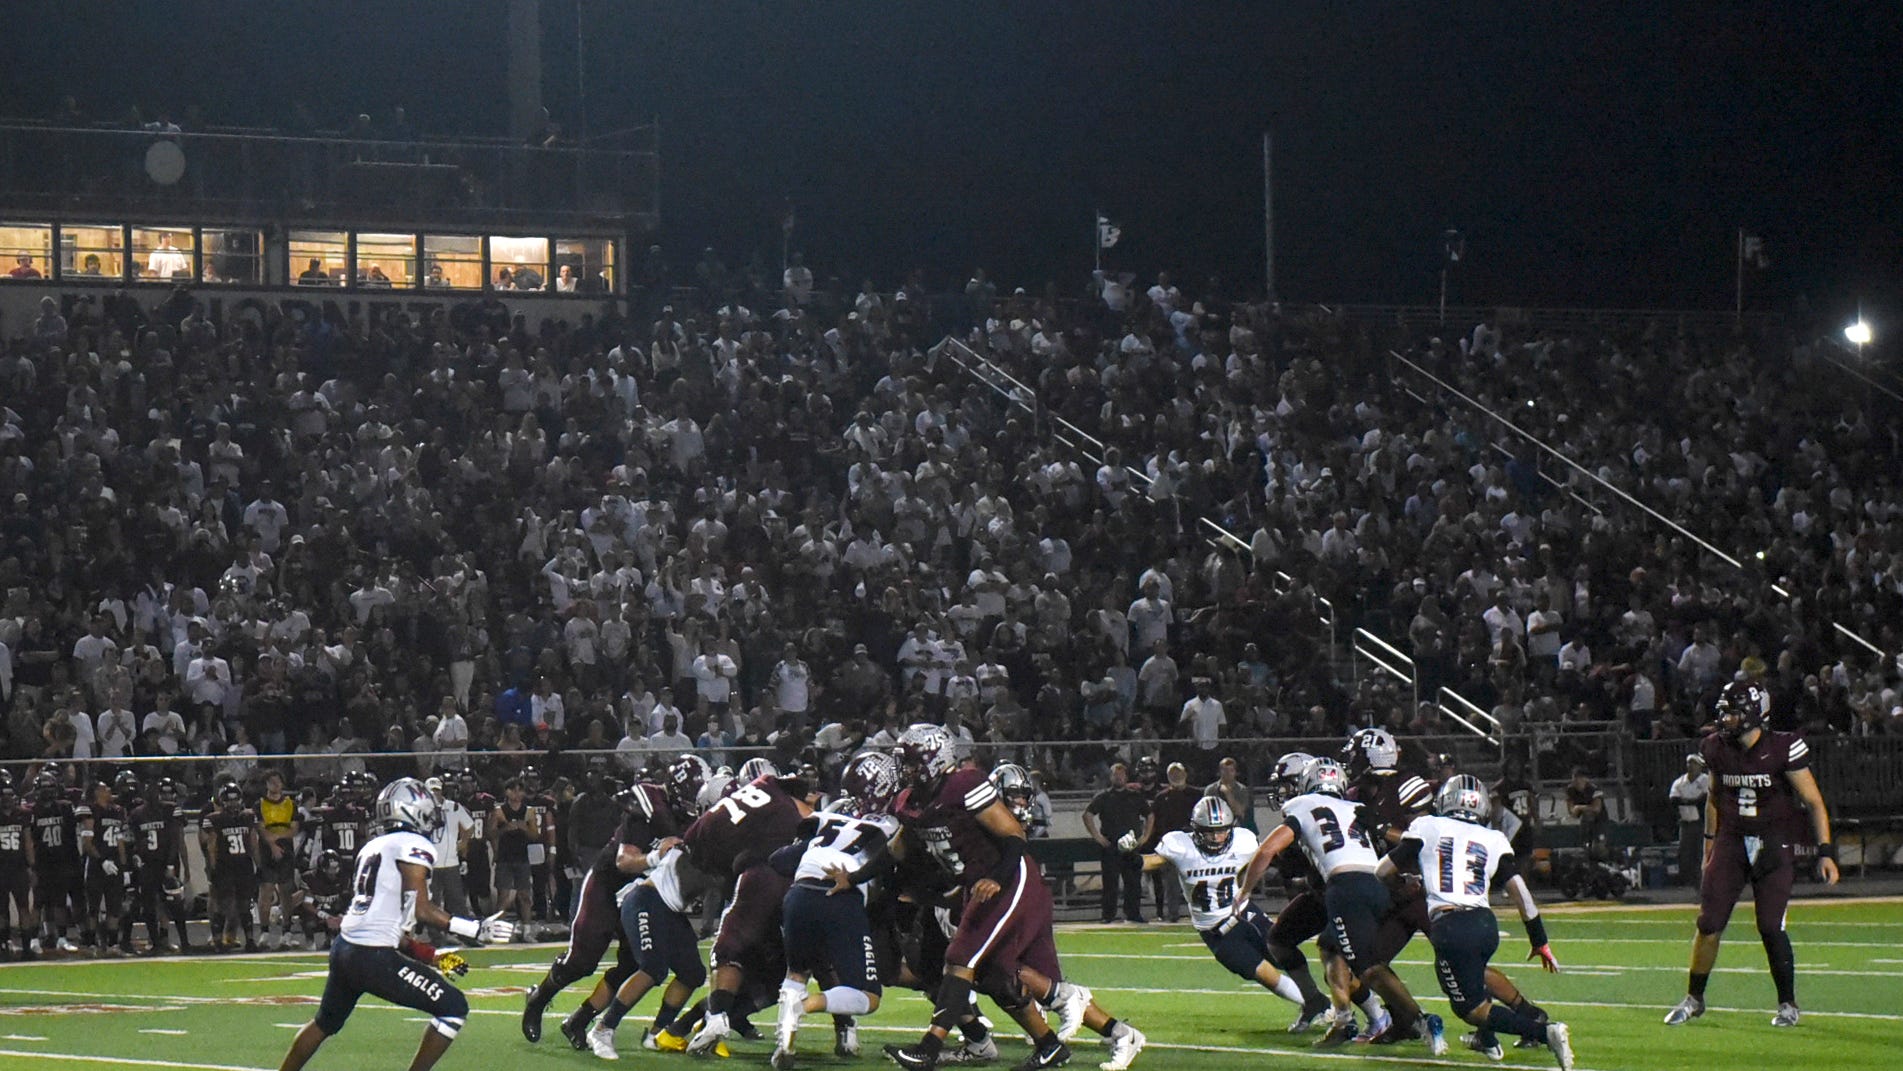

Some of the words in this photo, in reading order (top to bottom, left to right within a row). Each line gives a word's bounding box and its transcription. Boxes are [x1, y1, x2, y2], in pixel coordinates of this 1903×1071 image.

[1361, 735, 1377, 748] 21
[857, 760, 880, 780] 72
[1722, 774, 1772, 788] HORNETS
[709, 785, 772, 825] 78
[1738, 788, 1758, 817] 2
[0, 832, 21, 851] 56
[42, 826, 62, 848] 40
[227, 834, 247, 855] 31
[338, 829, 355, 850] 10
[1187, 866, 1237, 878] VETERANS
[1437, 837, 1488, 896] 13
[638, 911, 653, 952] EAGLES
[1332, 916, 1356, 961] EAGLES
[862, 935, 879, 982] EAGLES
[397, 965, 445, 1002] EAGLES
[1439, 959, 1466, 1003] EAGLES
